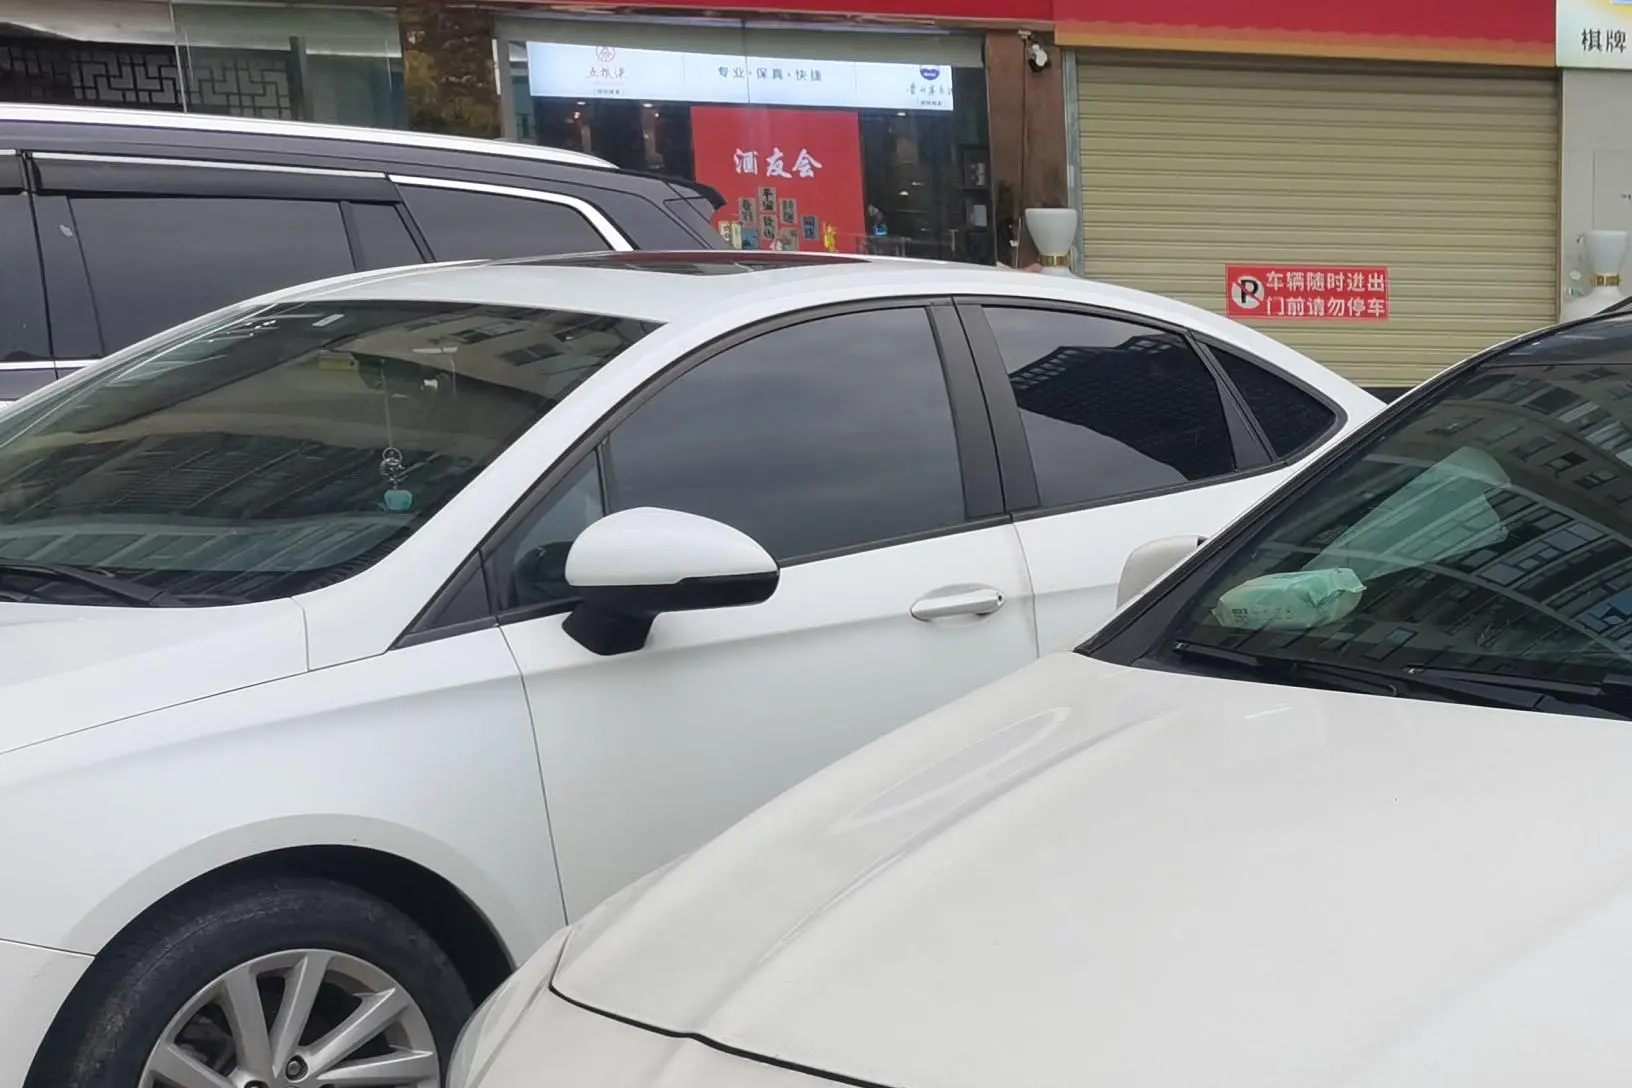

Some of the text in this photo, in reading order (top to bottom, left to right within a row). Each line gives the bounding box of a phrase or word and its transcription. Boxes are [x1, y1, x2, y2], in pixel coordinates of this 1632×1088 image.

[1581, 28, 1627, 54] 棋牌
[733, 147, 823, 179] 酒友会
[1266, 270, 1385, 293] 车辆随时进出
[1266, 297, 1386, 317] 门前请勿停车
